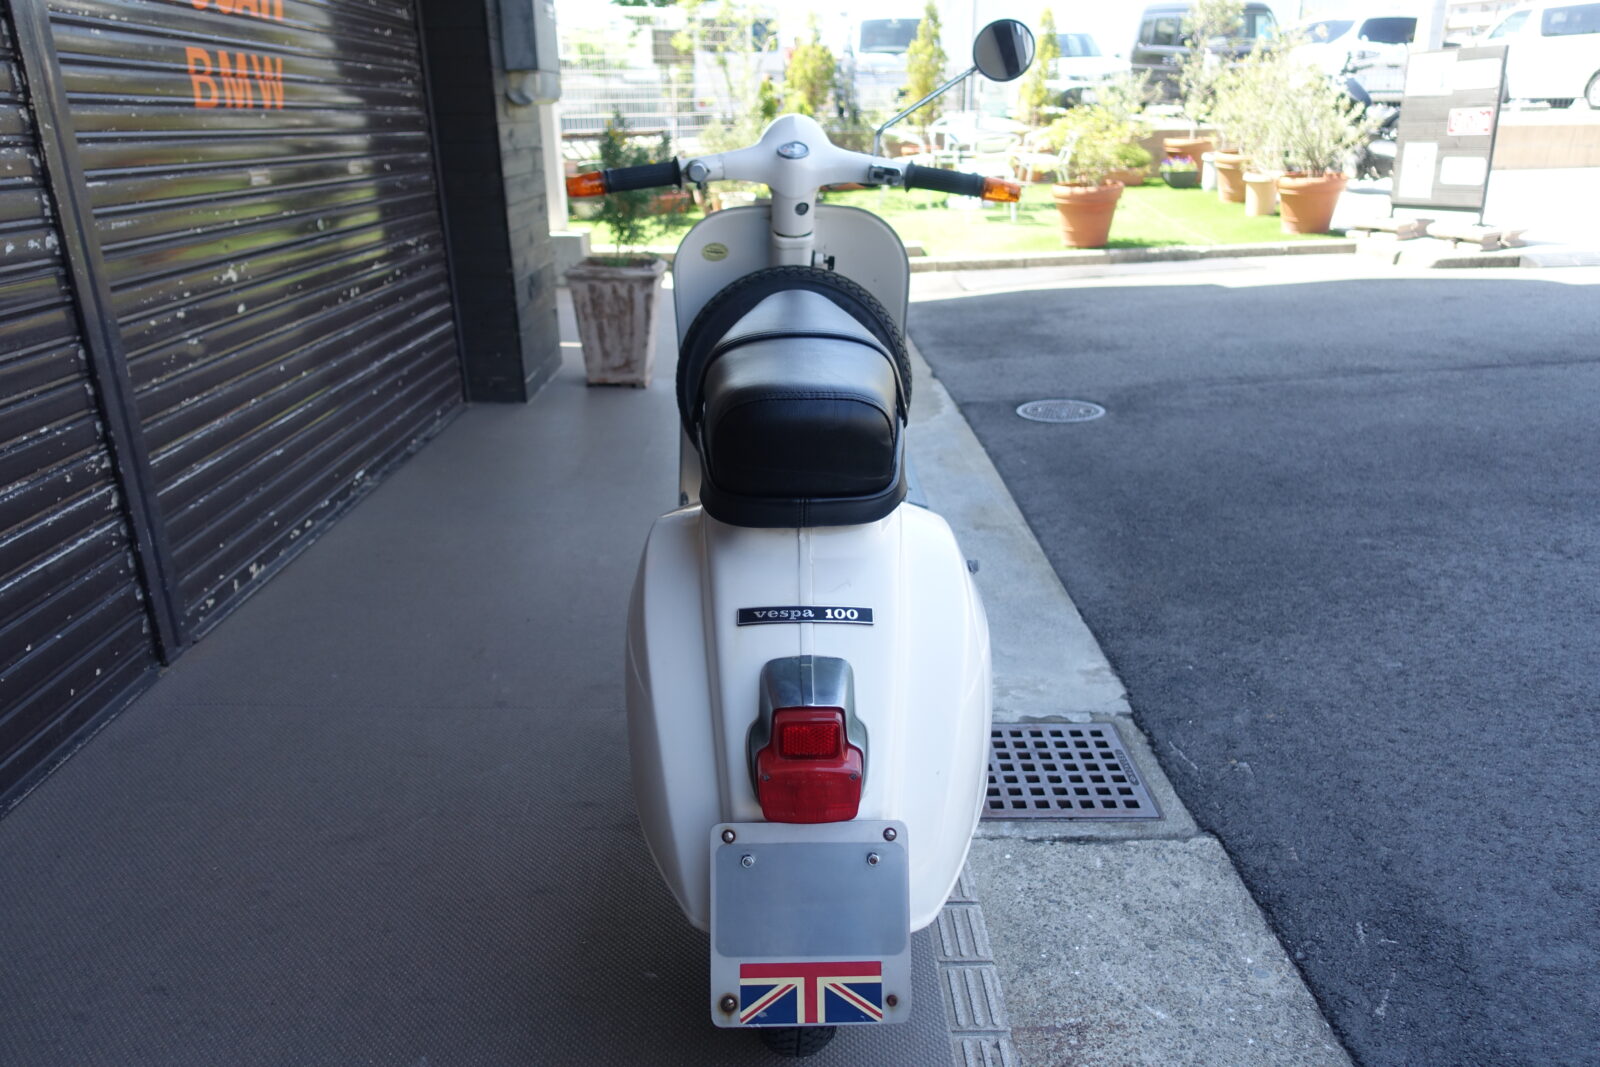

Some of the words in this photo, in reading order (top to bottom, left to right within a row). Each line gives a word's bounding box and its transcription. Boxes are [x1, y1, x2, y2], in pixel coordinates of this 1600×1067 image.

[185, 46, 284, 110] BMW
[753, 608, 815, 620] vespa
[824, 608, 859, 619] 100
